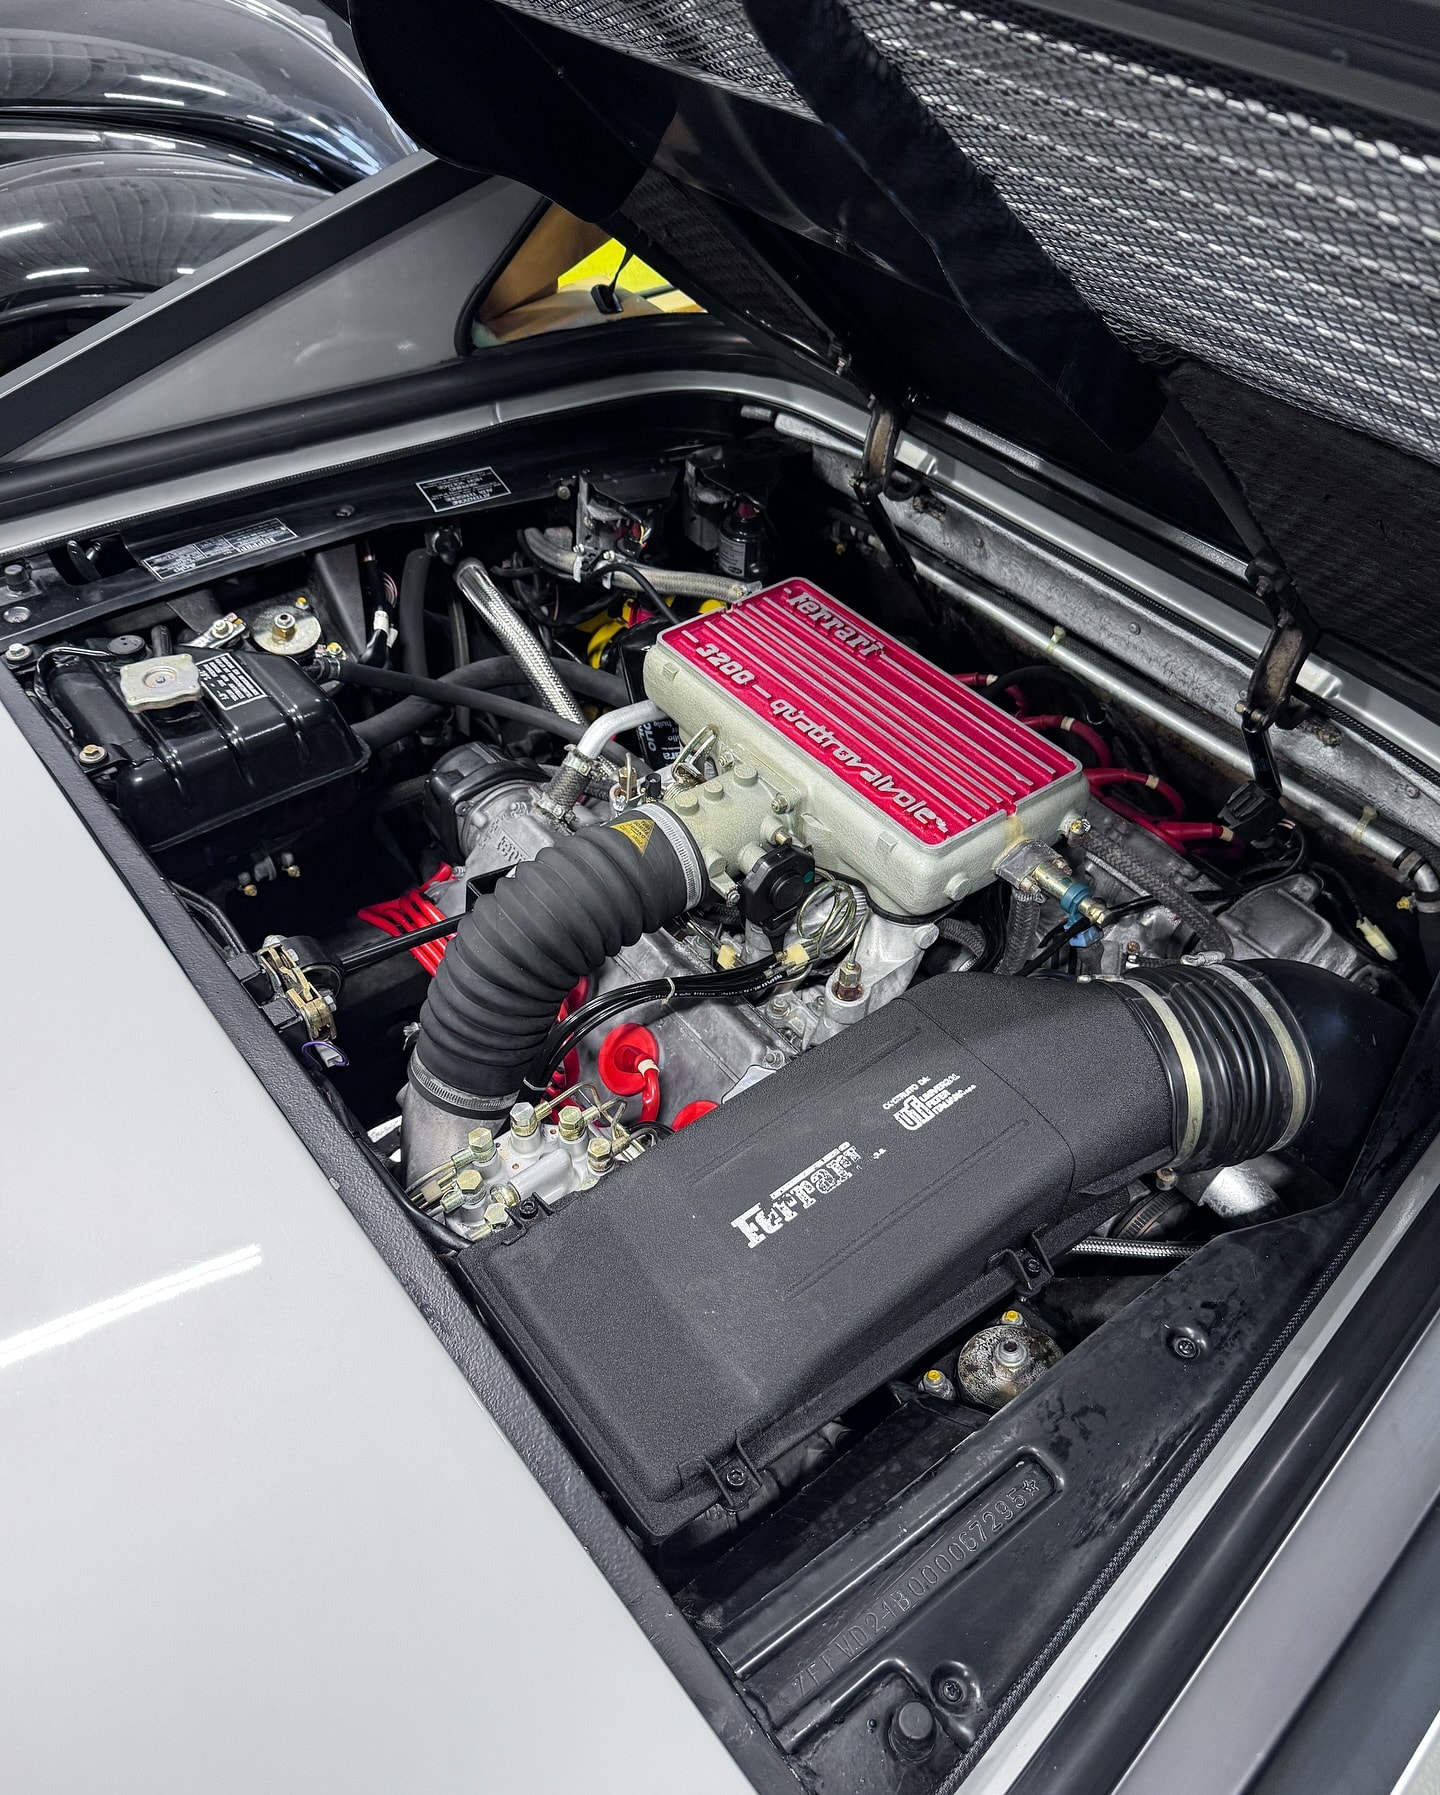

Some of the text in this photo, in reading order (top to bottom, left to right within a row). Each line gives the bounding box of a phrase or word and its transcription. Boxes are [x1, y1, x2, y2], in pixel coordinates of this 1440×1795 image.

[786, 591, 884, 656] Ferrari
[696, 643, 937, 824] 3200 quattrovalvole
